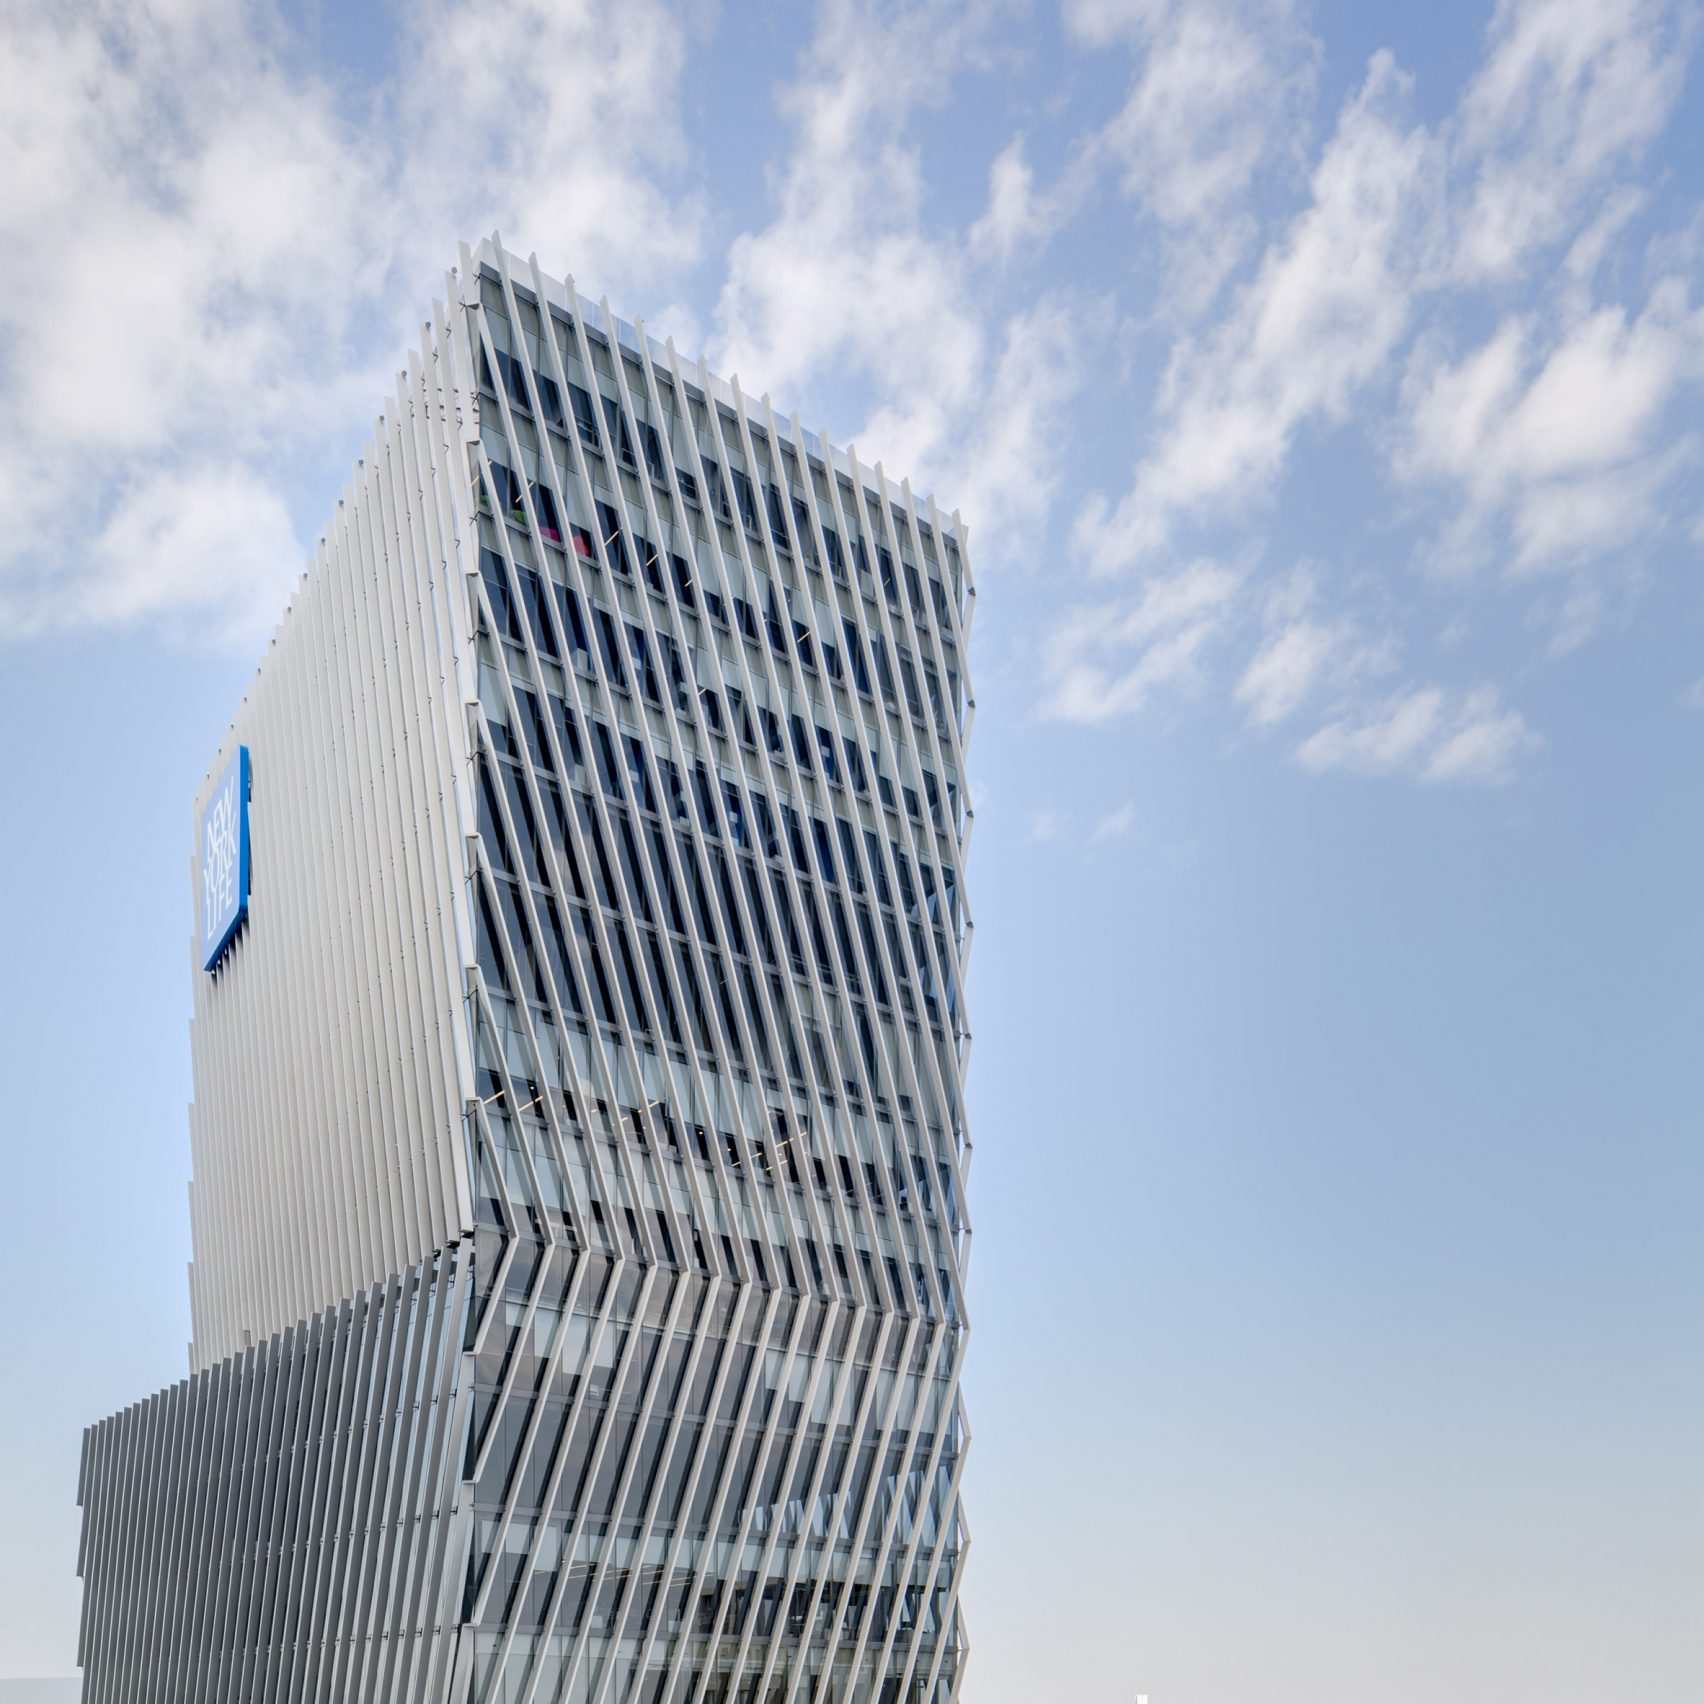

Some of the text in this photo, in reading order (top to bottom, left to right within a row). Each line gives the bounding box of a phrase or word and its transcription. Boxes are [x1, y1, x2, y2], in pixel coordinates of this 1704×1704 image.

[203, 811, 237, 905] YORK
[207, 775, 234, 864] NEW
[207, 860, 233, 941] LIFE
